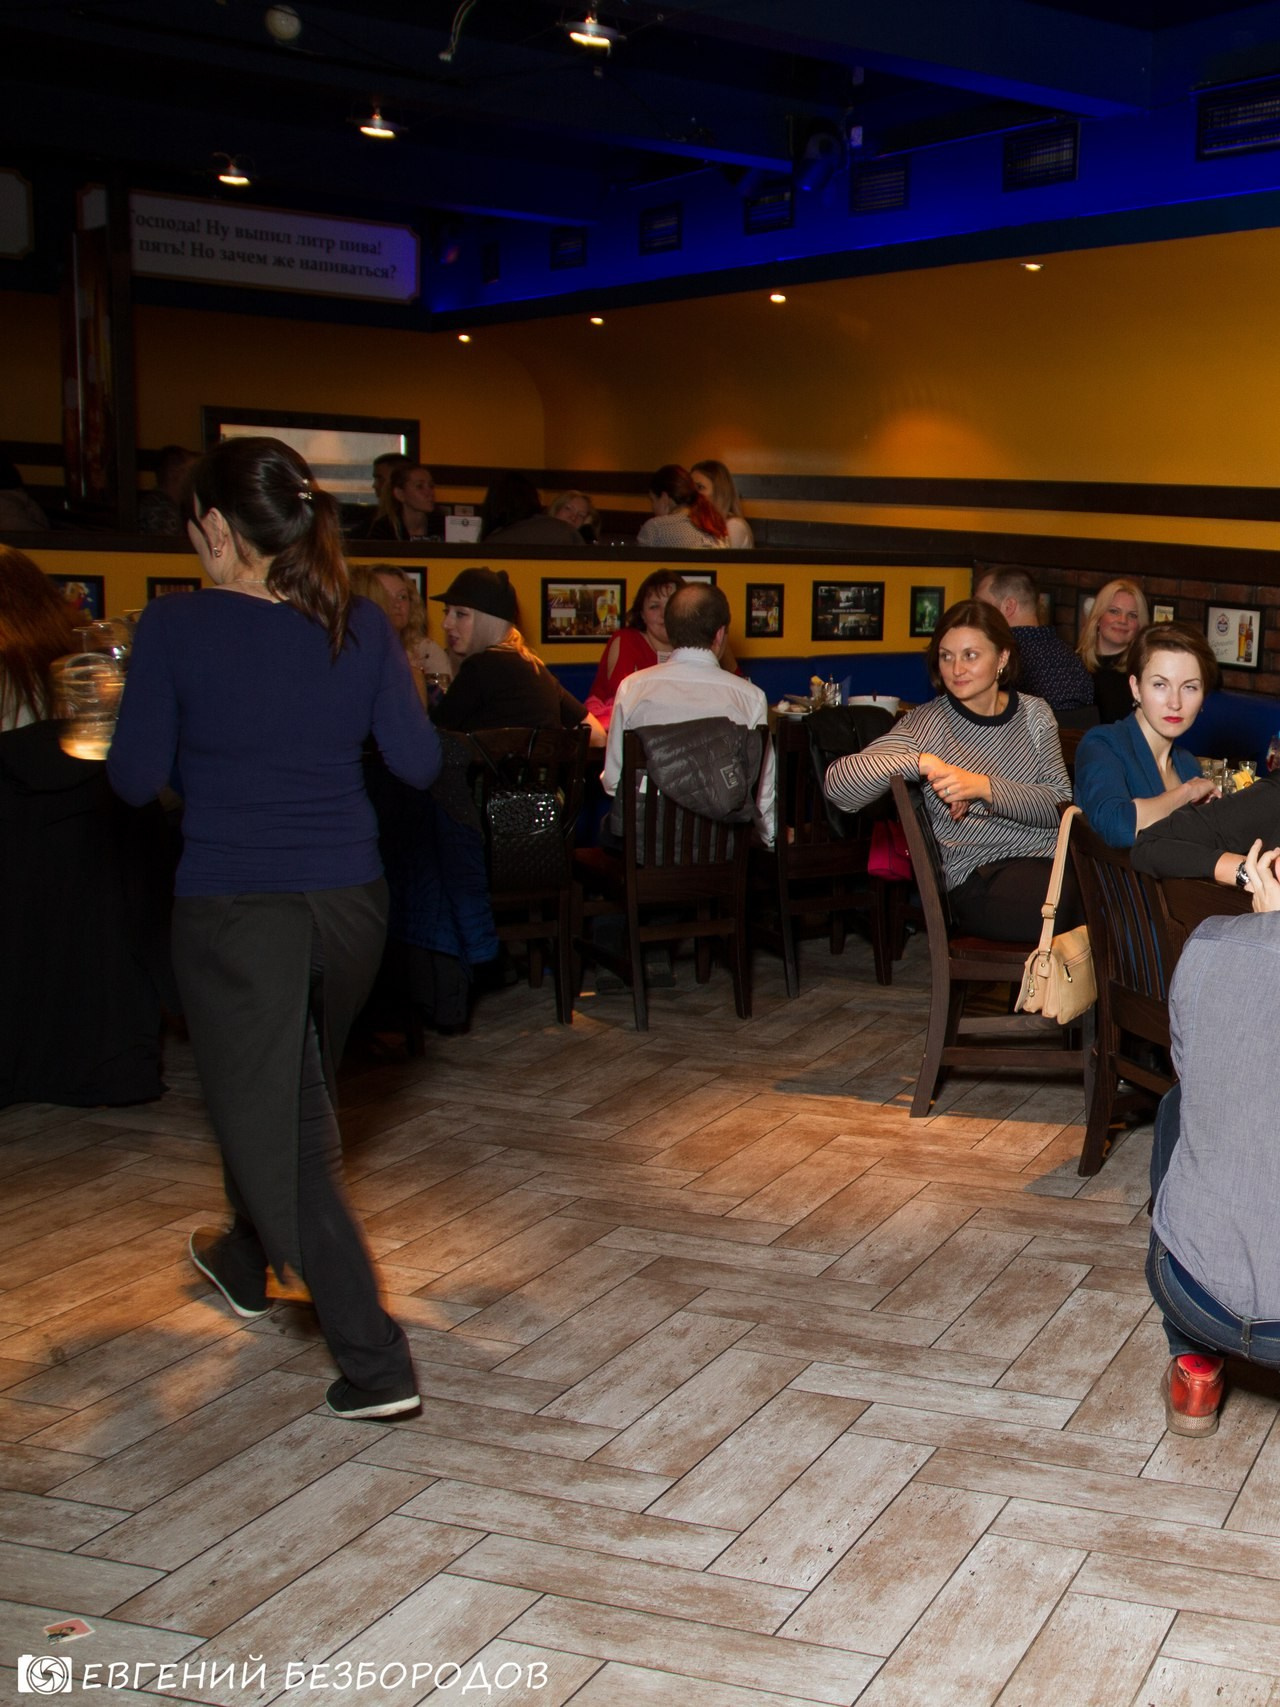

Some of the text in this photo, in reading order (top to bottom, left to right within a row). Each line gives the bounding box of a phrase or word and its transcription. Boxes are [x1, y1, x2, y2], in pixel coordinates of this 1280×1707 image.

[206, 219, 229, 242] Ну
[234, 227, 292, 245] выпил
[296, 234, 335, 254] литр
[339, 240, 382, 255] пива!
[138, 239, 397, 279] пять! Но зачем же напиваться?
